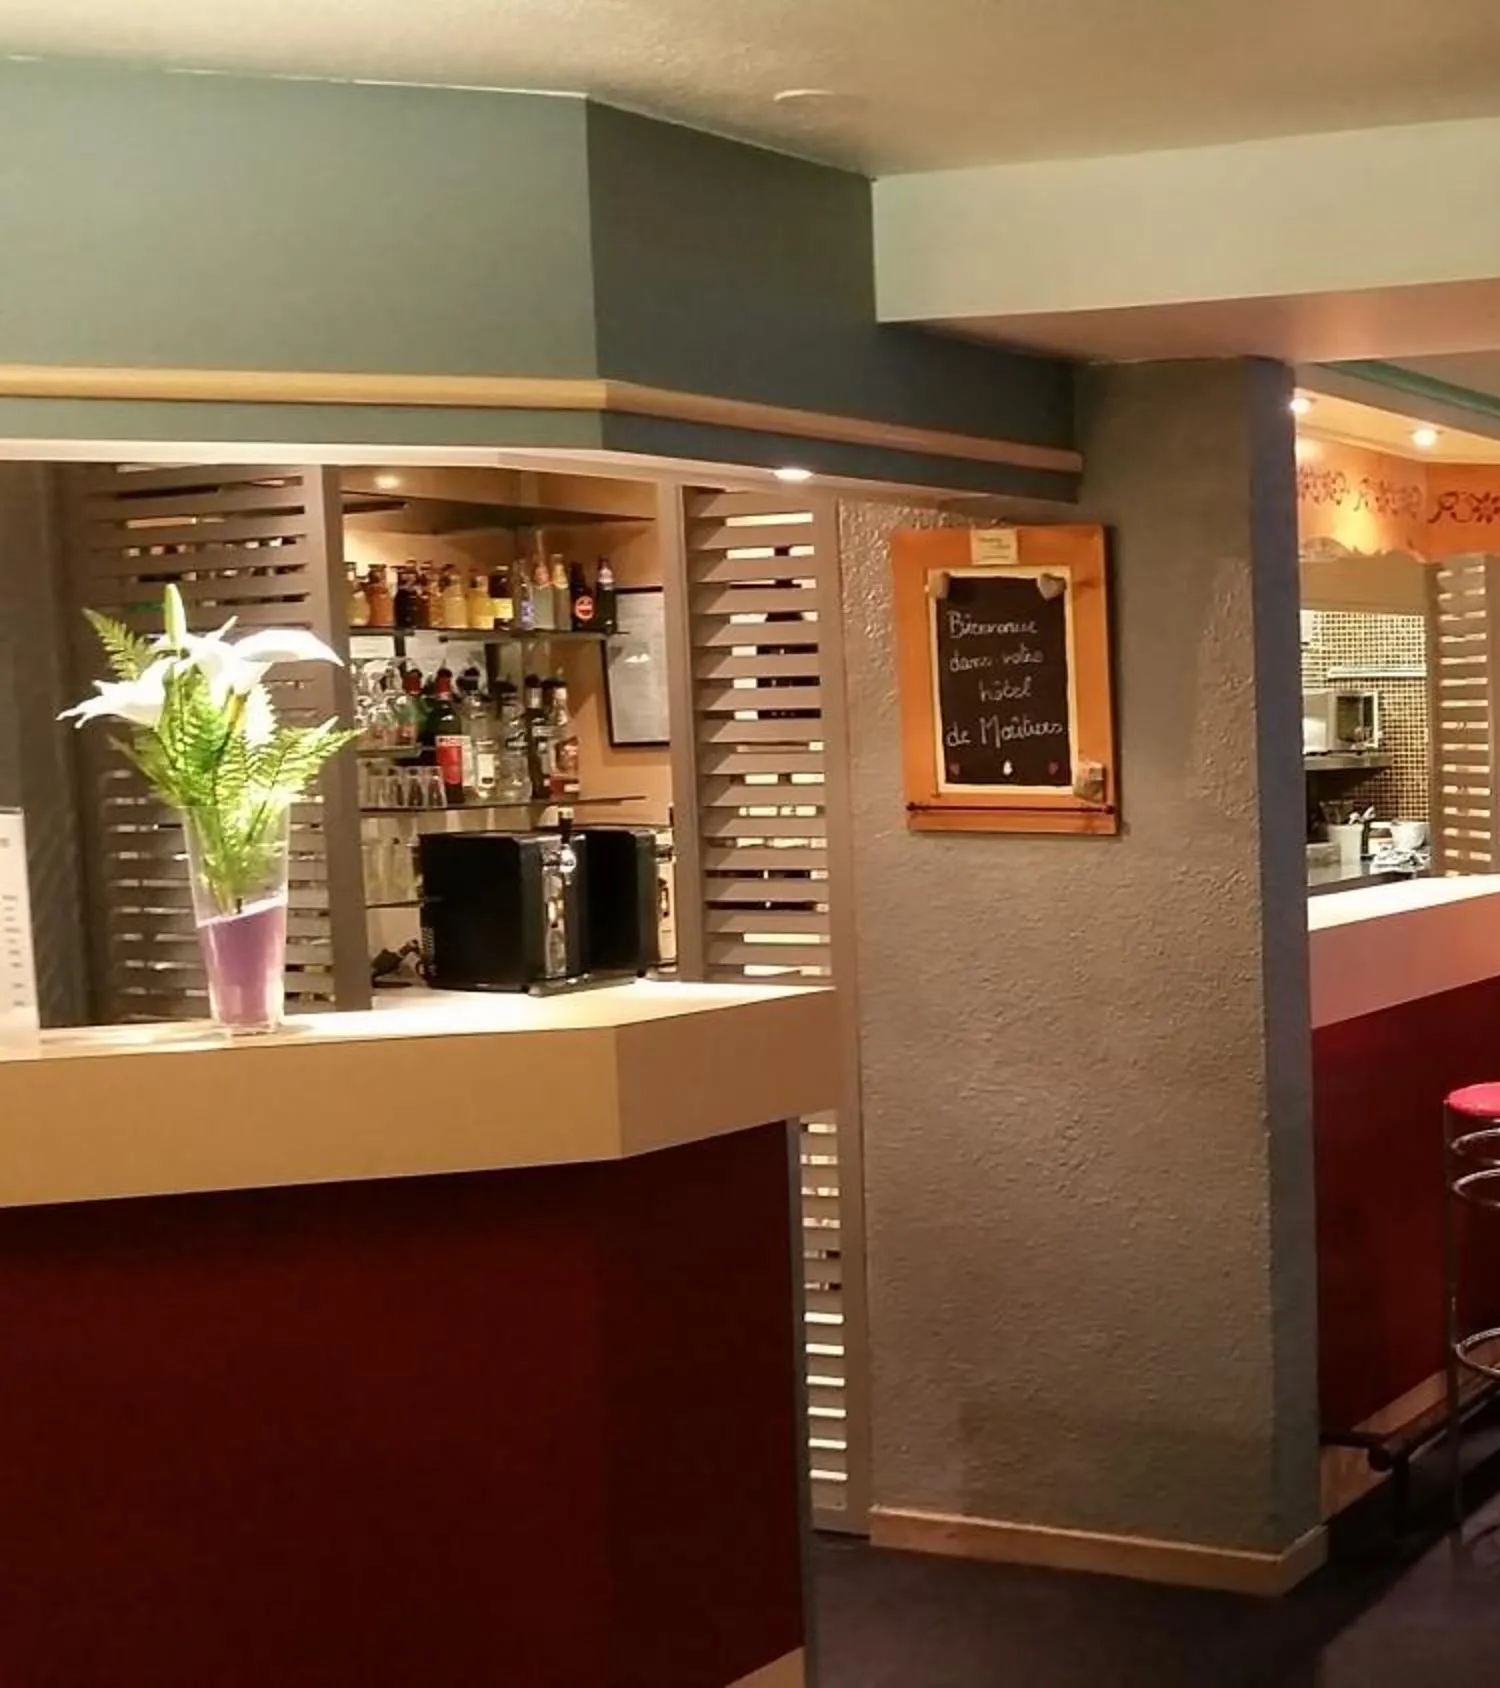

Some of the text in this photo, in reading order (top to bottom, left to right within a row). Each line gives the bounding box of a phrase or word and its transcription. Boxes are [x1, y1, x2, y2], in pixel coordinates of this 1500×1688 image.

[949, 648, 992, 673] dans
[977, 675, 1032, 702] hôtel
[946, 720, 971, 747] de
